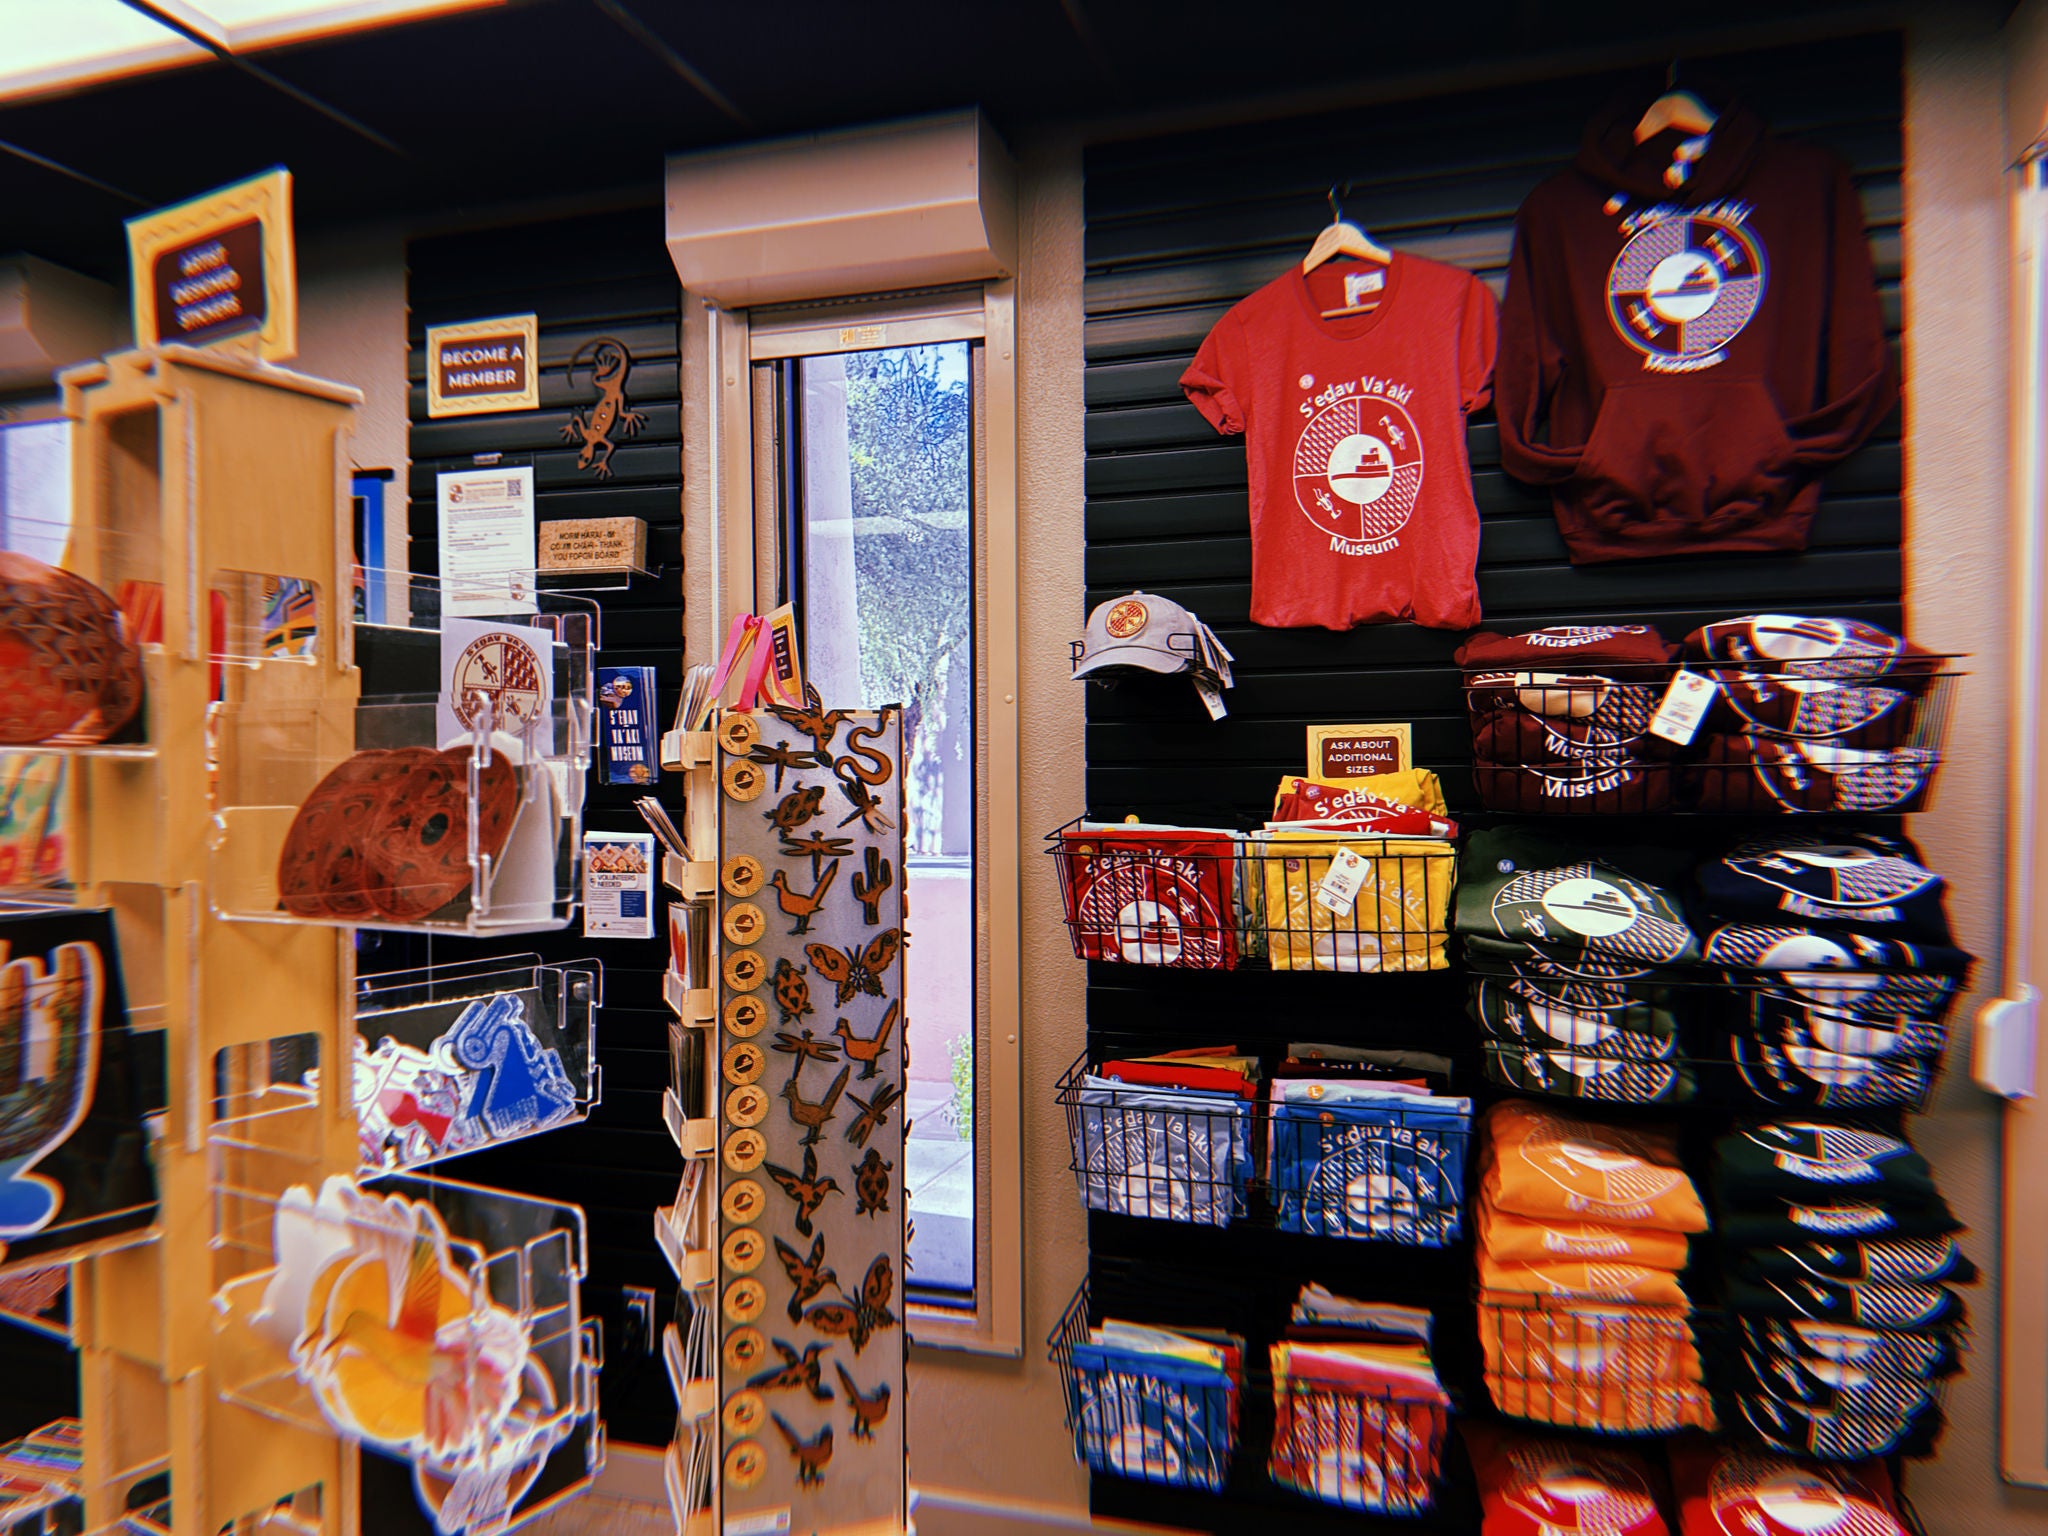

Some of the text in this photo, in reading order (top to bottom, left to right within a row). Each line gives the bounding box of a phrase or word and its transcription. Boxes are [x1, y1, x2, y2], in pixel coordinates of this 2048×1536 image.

[441, 343, 524, 367] BECOME A
[448, 367, 517, 389] MEMBER
[1361, 376, 1414, 405] Va'aki
[1329, 537, 1400, 556] Museum
[1526, 633, 1614, 647] Museum
[611, 729, 640, 744] VA'AKI
[1330, 740, 1391, 750] ASK ABOUT
[1545, 734, 1629, 759] Museum
[610, 746, 643, 762] MUSEUM
[1328, 752, 1393, 762] ADDITIONAL
[1346, 765, 1375, 774] SIZES
[1541, 768, 1632, 798] Museum
[1500, 862, 1510, 871] M
